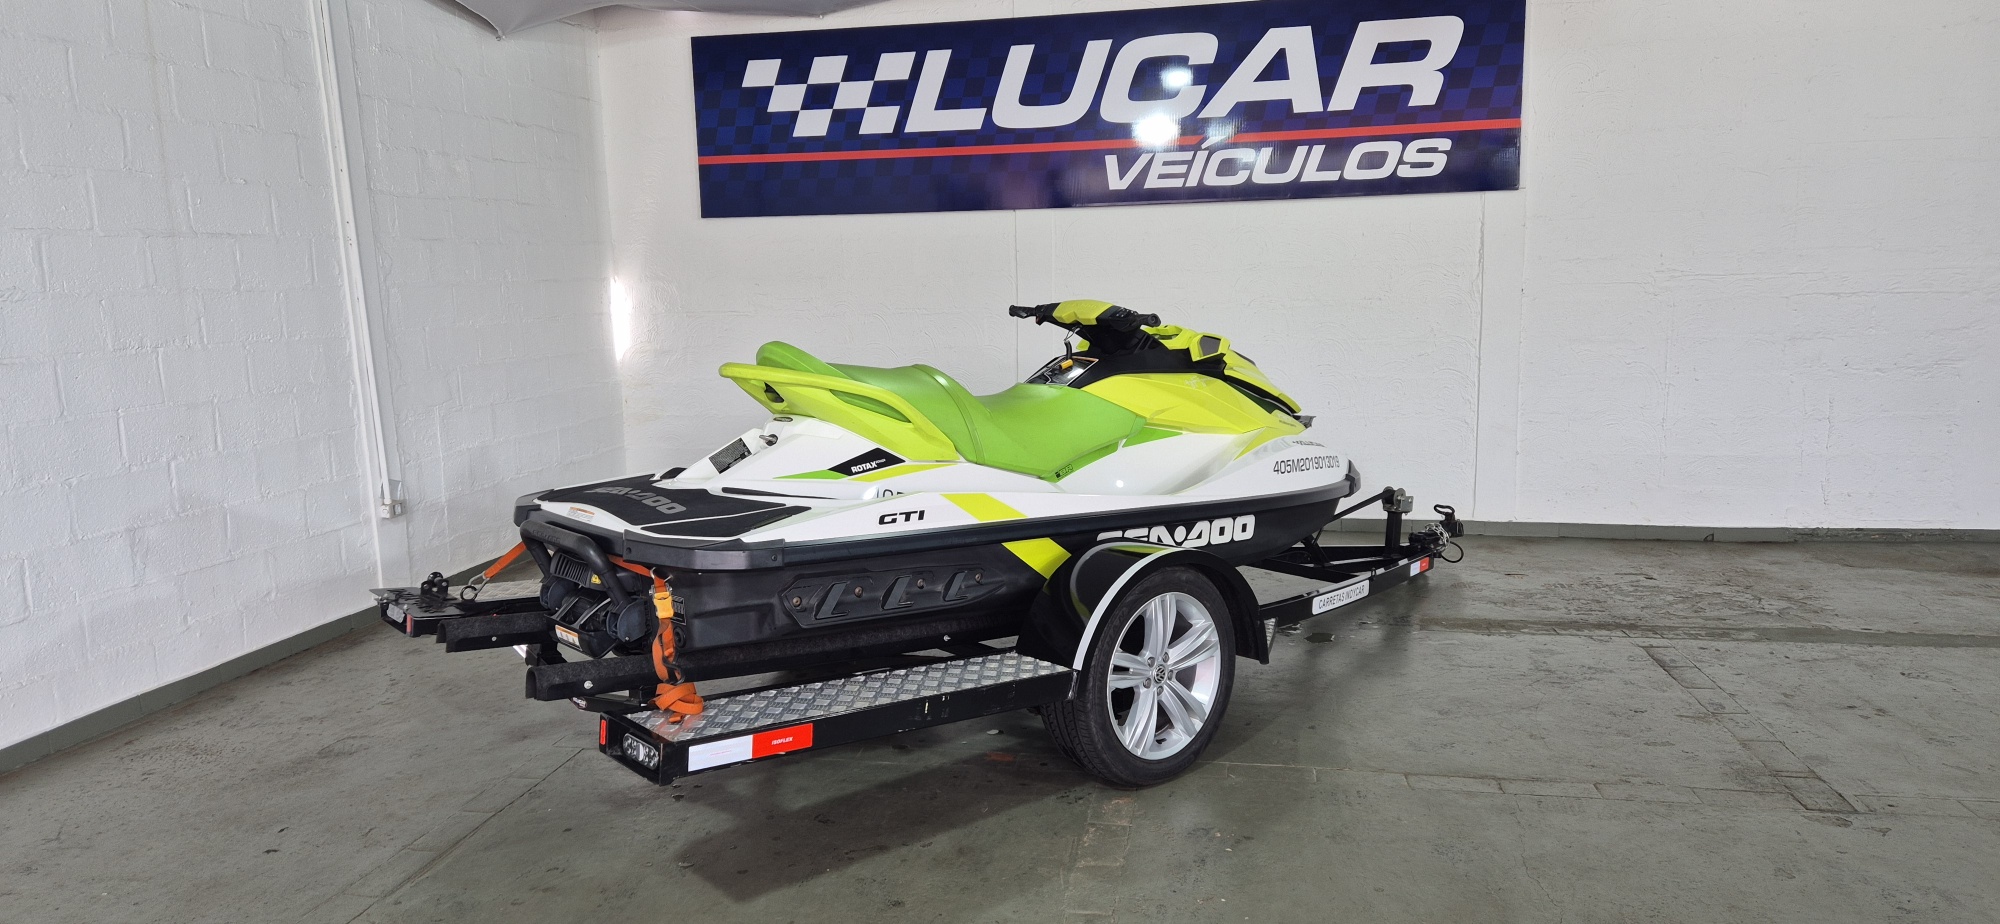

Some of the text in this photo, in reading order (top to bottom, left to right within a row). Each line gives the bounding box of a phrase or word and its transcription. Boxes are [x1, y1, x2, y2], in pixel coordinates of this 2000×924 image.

[904, 15, 1466, 133] LUCAR
[1105, 134, 1452, 190] VEÍCULOS
[850, 460, 877, 473] ROTAX
[879, 509, 925, 525] GTI
[1318, 592, 1345, 609] CARRETAS
